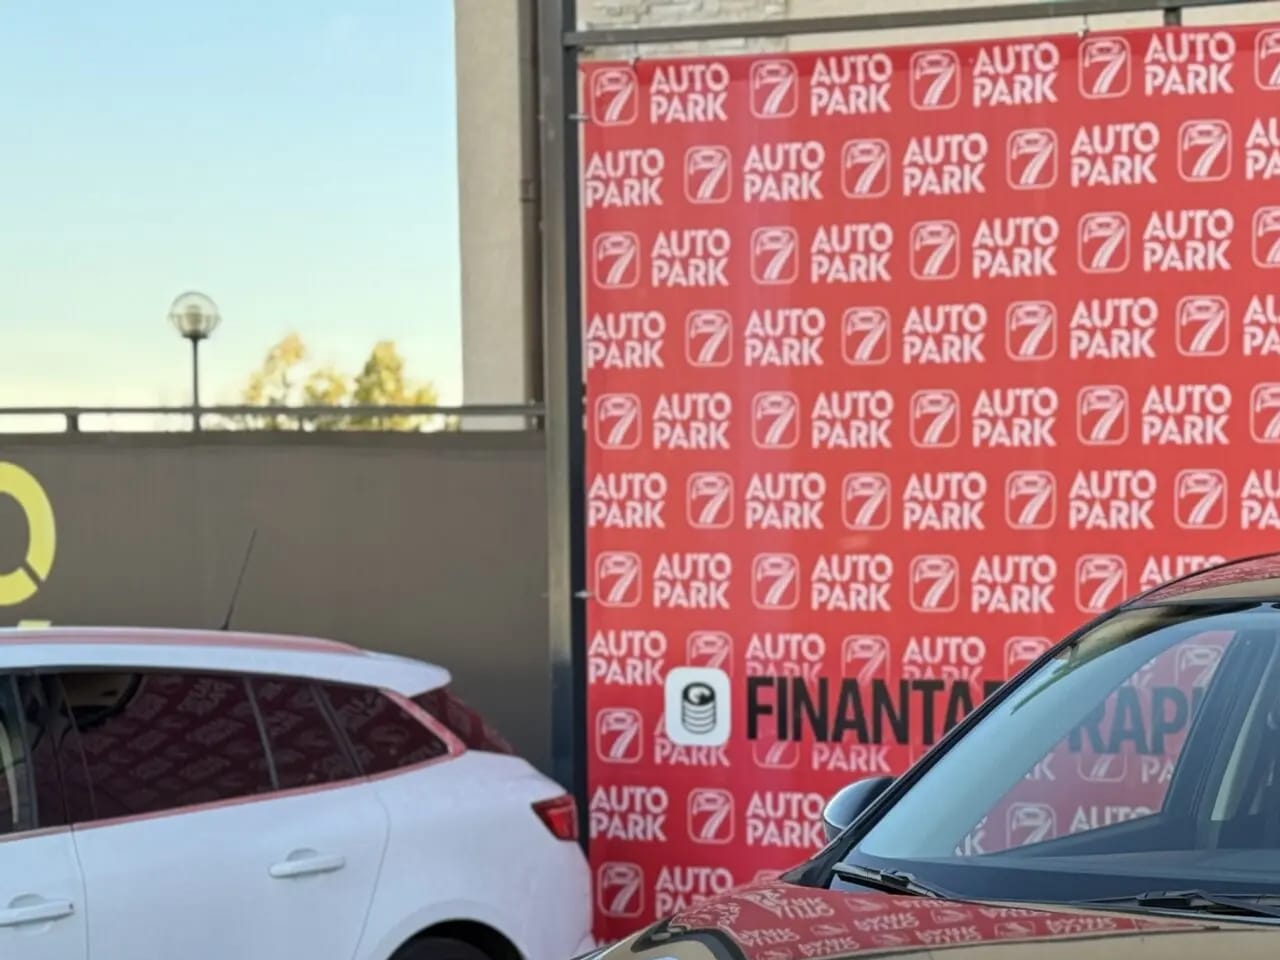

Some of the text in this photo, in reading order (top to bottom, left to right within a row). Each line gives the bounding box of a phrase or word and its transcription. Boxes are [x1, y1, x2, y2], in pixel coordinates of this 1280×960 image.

[972, 41, 1059, 76] AUTO
[1144, 31, 1236, 66] AUTO
[650, 60, 730, 94] AUTO
[811, 52, 892, 87] AUTO
[1145, 63, 1233, 95] PARK
[811, 83, 891, 116] PARK
[973, 72, 1057, 107] PARK
[650, 91, 728, 123] PARK
[903, 133, 987, 167] AUTO
[1071, 122, 1159, 156] AUTO
[586, 148, 664, 180] AUTO
[743, 141, 825, 173] AUTO
[1071, 153, 1156, 187] PARK
[586, 178, 662, 209] PARK
[744, 171, 822, 202] PARK
[904, 163, 984, 196] PARK
[811, 223, 893, 254] AUTO
[973, 216, 1059, 248] AUTO
[1143, 209, 1234, 240] AUTO
[651, 229, 730, 259] AUTO
[1144, 240, 1230, 271] PARK
[652, 257, 728, 287] PARK
[811, 252, 891, 283] PARK
[973, 246, 1056, 278] PARK
[586, 311, 665, 341] AUTO
[744, 308, 825, 336] AUTO
[903, 303, 987, 335] AUTO
[1070, 298, 1158, 328] AUTO
[587, 340, 663, 368] PARK
[745, 336, 823, 366] PARK
[904, 333, 984, 363] PARK
[1070, 328, 1155, 359] PARK
[653, 392, 731, 420] AUTO
[812, 390, 893, 419] AUTO
[973, 387, 1058, 417] AUTO
[1142, 384, 1231, 414] AUTO
[654, 420, 729, 449] PARK
[812, 419, 891, 448] PARK
[973, 417, 1055, 447] PARK
[1142, 414, 1228, 444] PARK
[588, 472, 667, 499] AUTO
[745, 473, 825, 500] AUTO
[903, 472, 986, 500] AUTO
[1069, 470, 1156, 499] AUTO
[588, 499, 664, 528] PARK
[746, 500, 823, 529] PARK
[904, 500, 984, 530] PARK
[1069, 499, 1153, 529] PARK
[654, 553, 732, 580] AUTO
[812, 554, 893, 581] AUTO
[972, 555, 1056, 583] AUTO
[654, 580, 729, 608] PARK
[812, 581, 890, 611] PARK
[972, 583, 1053, 613] PARK
[588, 630, 667, 658] AUTO
[744, 633, 826, 662] AUTO
[902, 636, 987, 665] AUTO
[588, 656, 666, 686] PARK
[812, 745, 891, 773] PARK
[590, 786, 668, 814] AUTO
[746, 792, 825, 821] AUTO
[590, 811, 666, 841] PARK
[747, 818, 826, 849] PARK
[655, 866, 734, 895] AUTO
